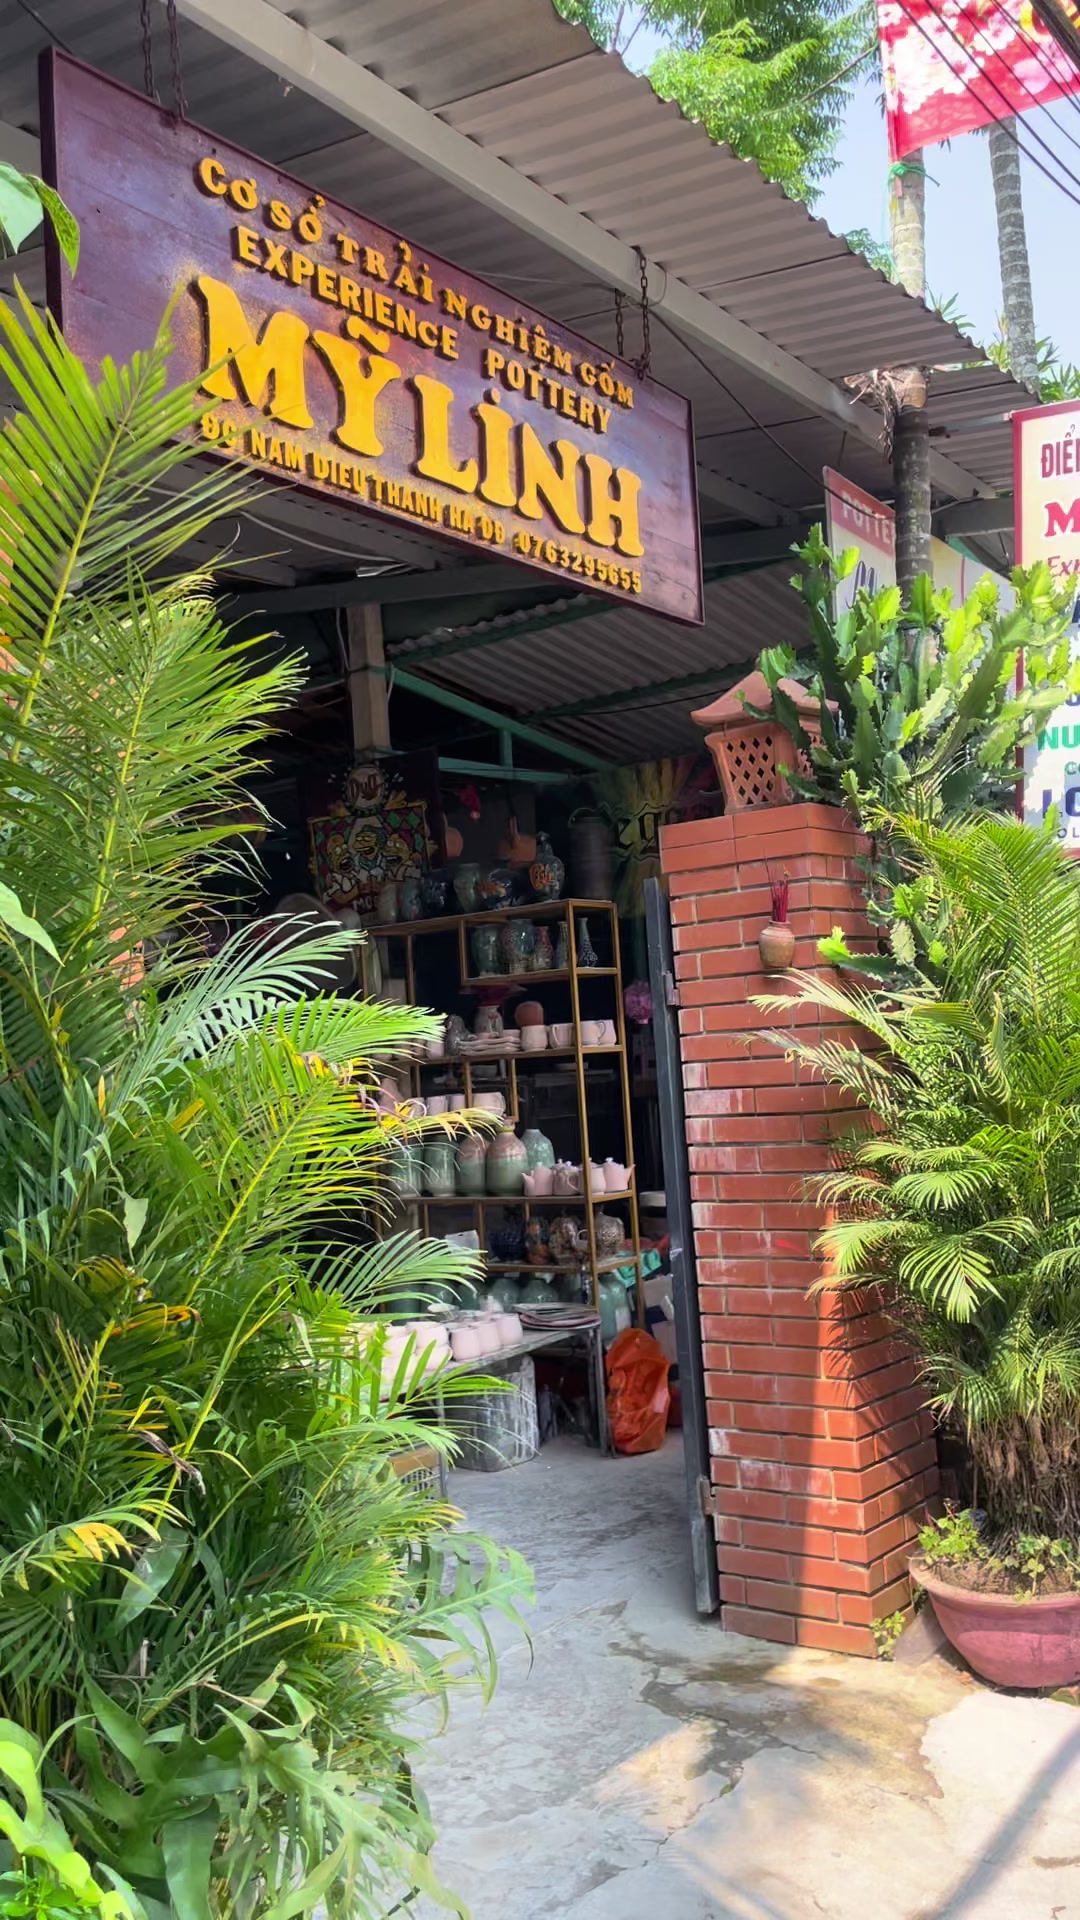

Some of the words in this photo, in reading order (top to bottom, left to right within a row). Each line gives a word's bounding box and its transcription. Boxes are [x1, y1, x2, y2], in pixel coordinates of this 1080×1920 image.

[198, 157, 258, 211] CƠ
[197, 275, 401, 457] MỸ
[236, 225, 459, 360] EXPERIENCE
[487, 348, 612, 433] POTTERY
[251, 428, 302, 472] NAM
[373, 474, 441, 521] THANH
